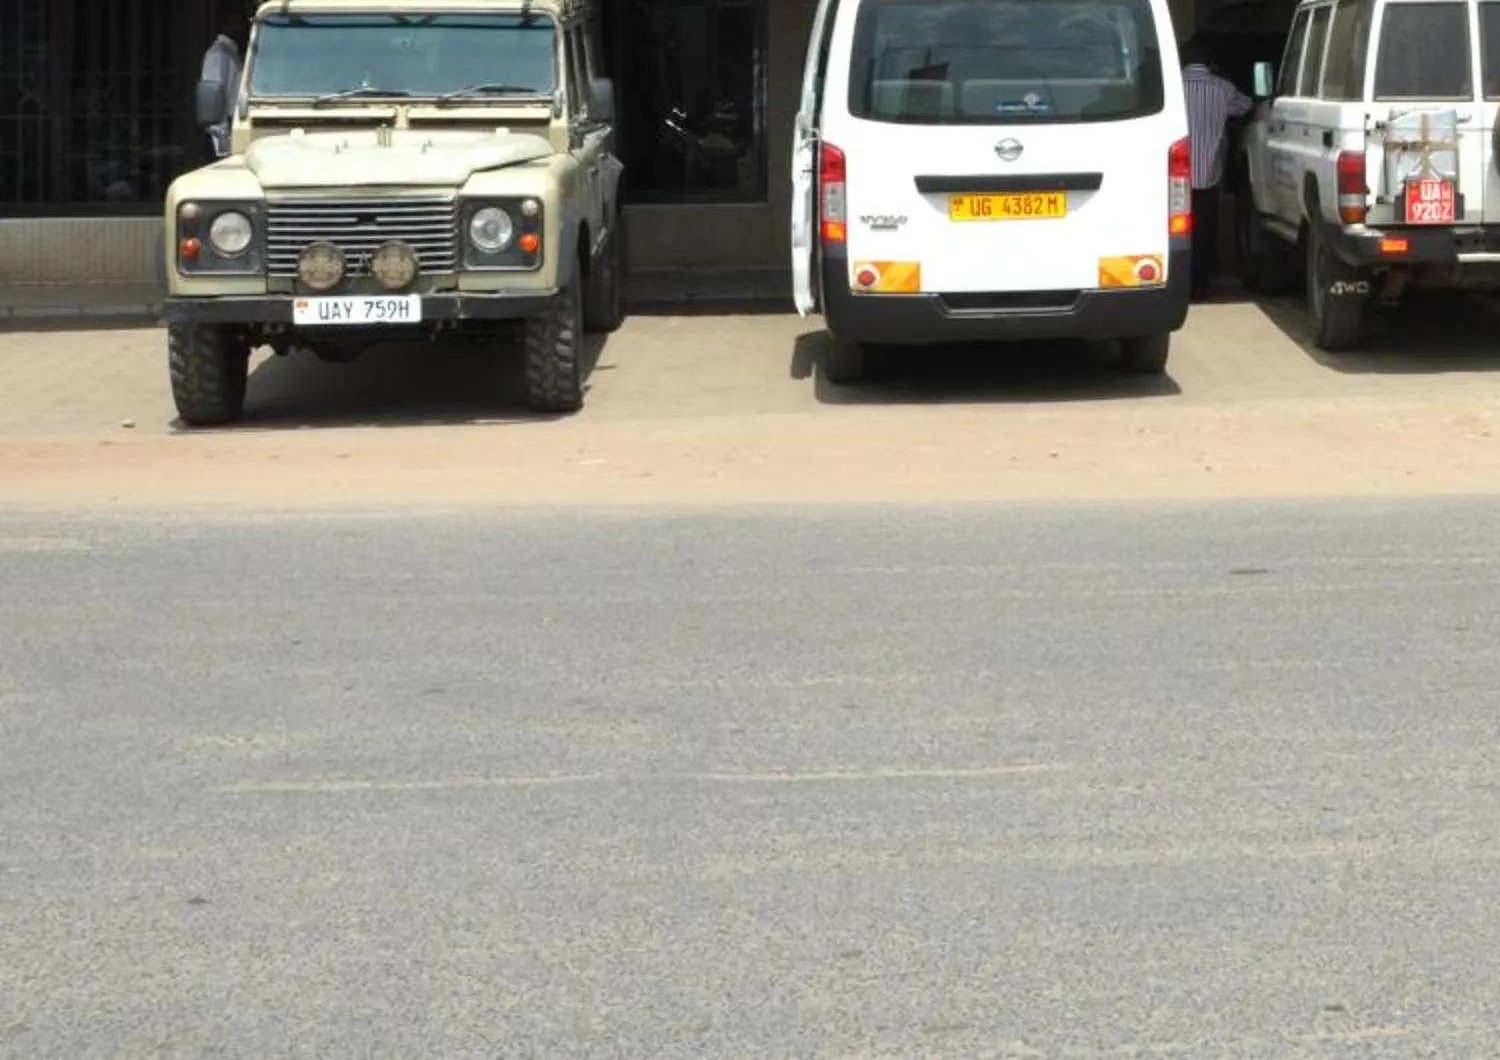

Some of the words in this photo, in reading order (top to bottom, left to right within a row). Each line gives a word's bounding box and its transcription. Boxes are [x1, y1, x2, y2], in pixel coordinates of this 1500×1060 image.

[969, 196, 992, 217] UG
[1002, 196, 1043, 216] 4382
[319, 301, 353, 320] UAY
[363, 300, 409, 319] 759H
